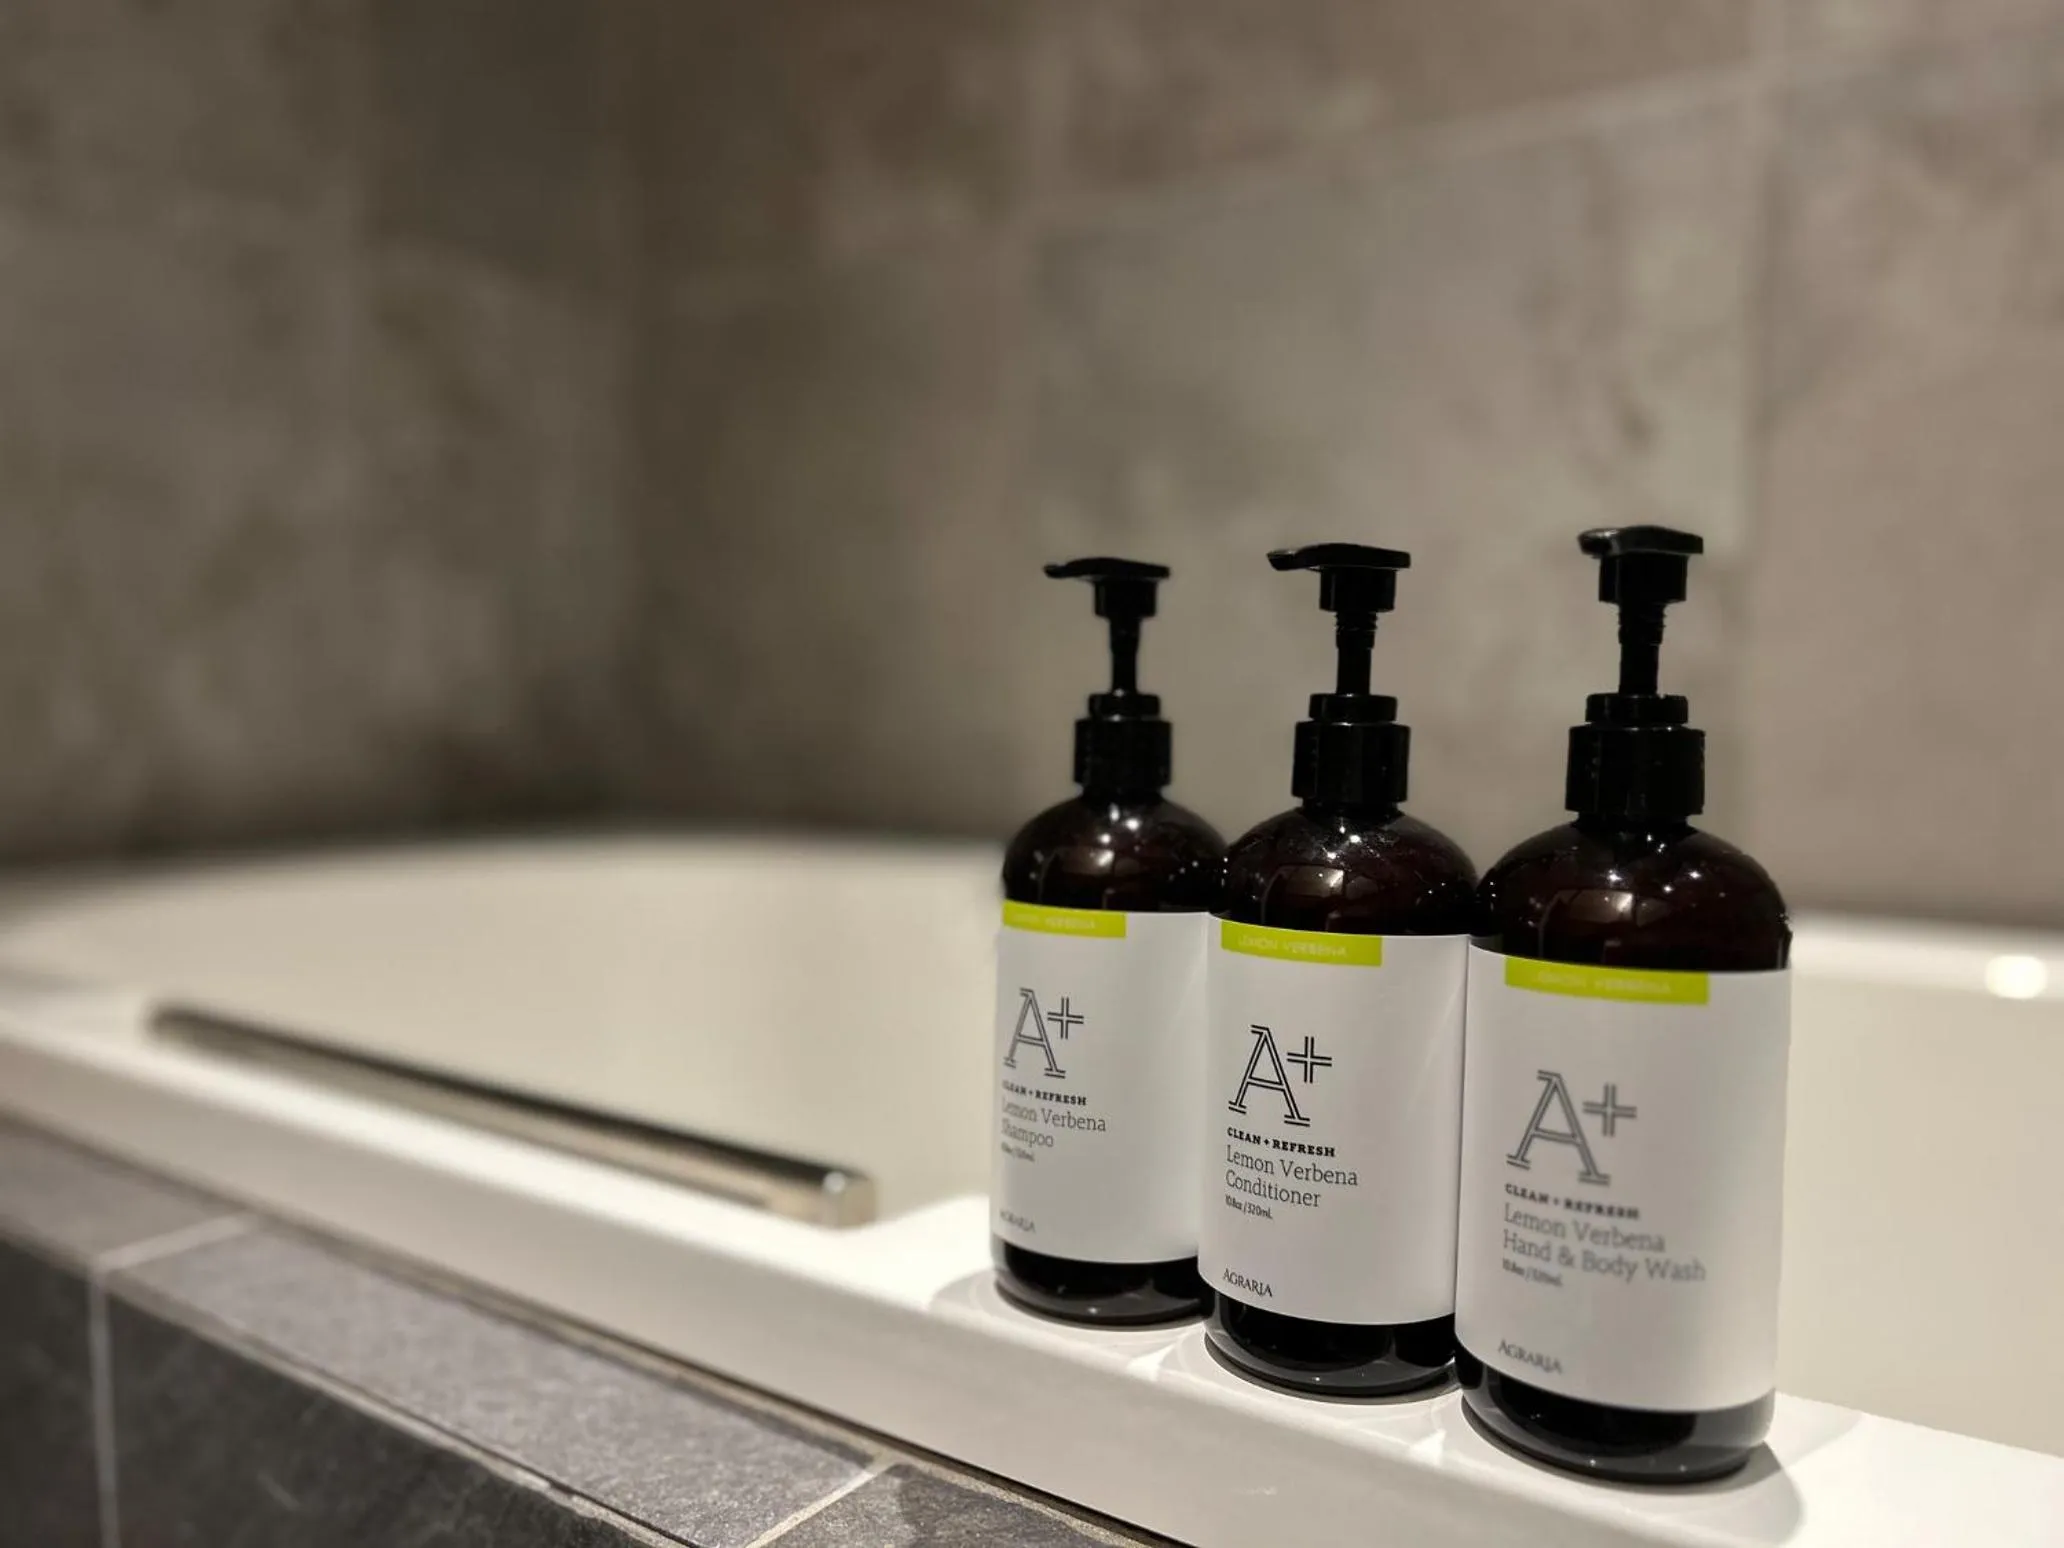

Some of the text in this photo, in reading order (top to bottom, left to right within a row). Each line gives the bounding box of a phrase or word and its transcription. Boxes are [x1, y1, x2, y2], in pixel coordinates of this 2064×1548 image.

[1035, 1089, 1087, 1106] REFRESH
[1041, 1107, 1106, 1132] Verbena
[1227, 1127, 1261, 1145] CLEAN
[1272, 1139, 1336, 1157] REFRESH
[1227, 1144, 1358, 1186] Lemon Verbena
[1226, 1169, 1321, 1207] Conditioner
[1505, 1183, 1549, 1205] CLEAN
[1563, 1198, 1640, 1220] REFRESH
[1504, 1202, 1666, 1253] Lemon Verbena
[1504, 1228, 1552, 1262] Hand
[1558, 1245, 1576, 1268] &
[1582, 1249, 1639, 1284] Body
[1645, 1257, 1707, 1282] Wash
